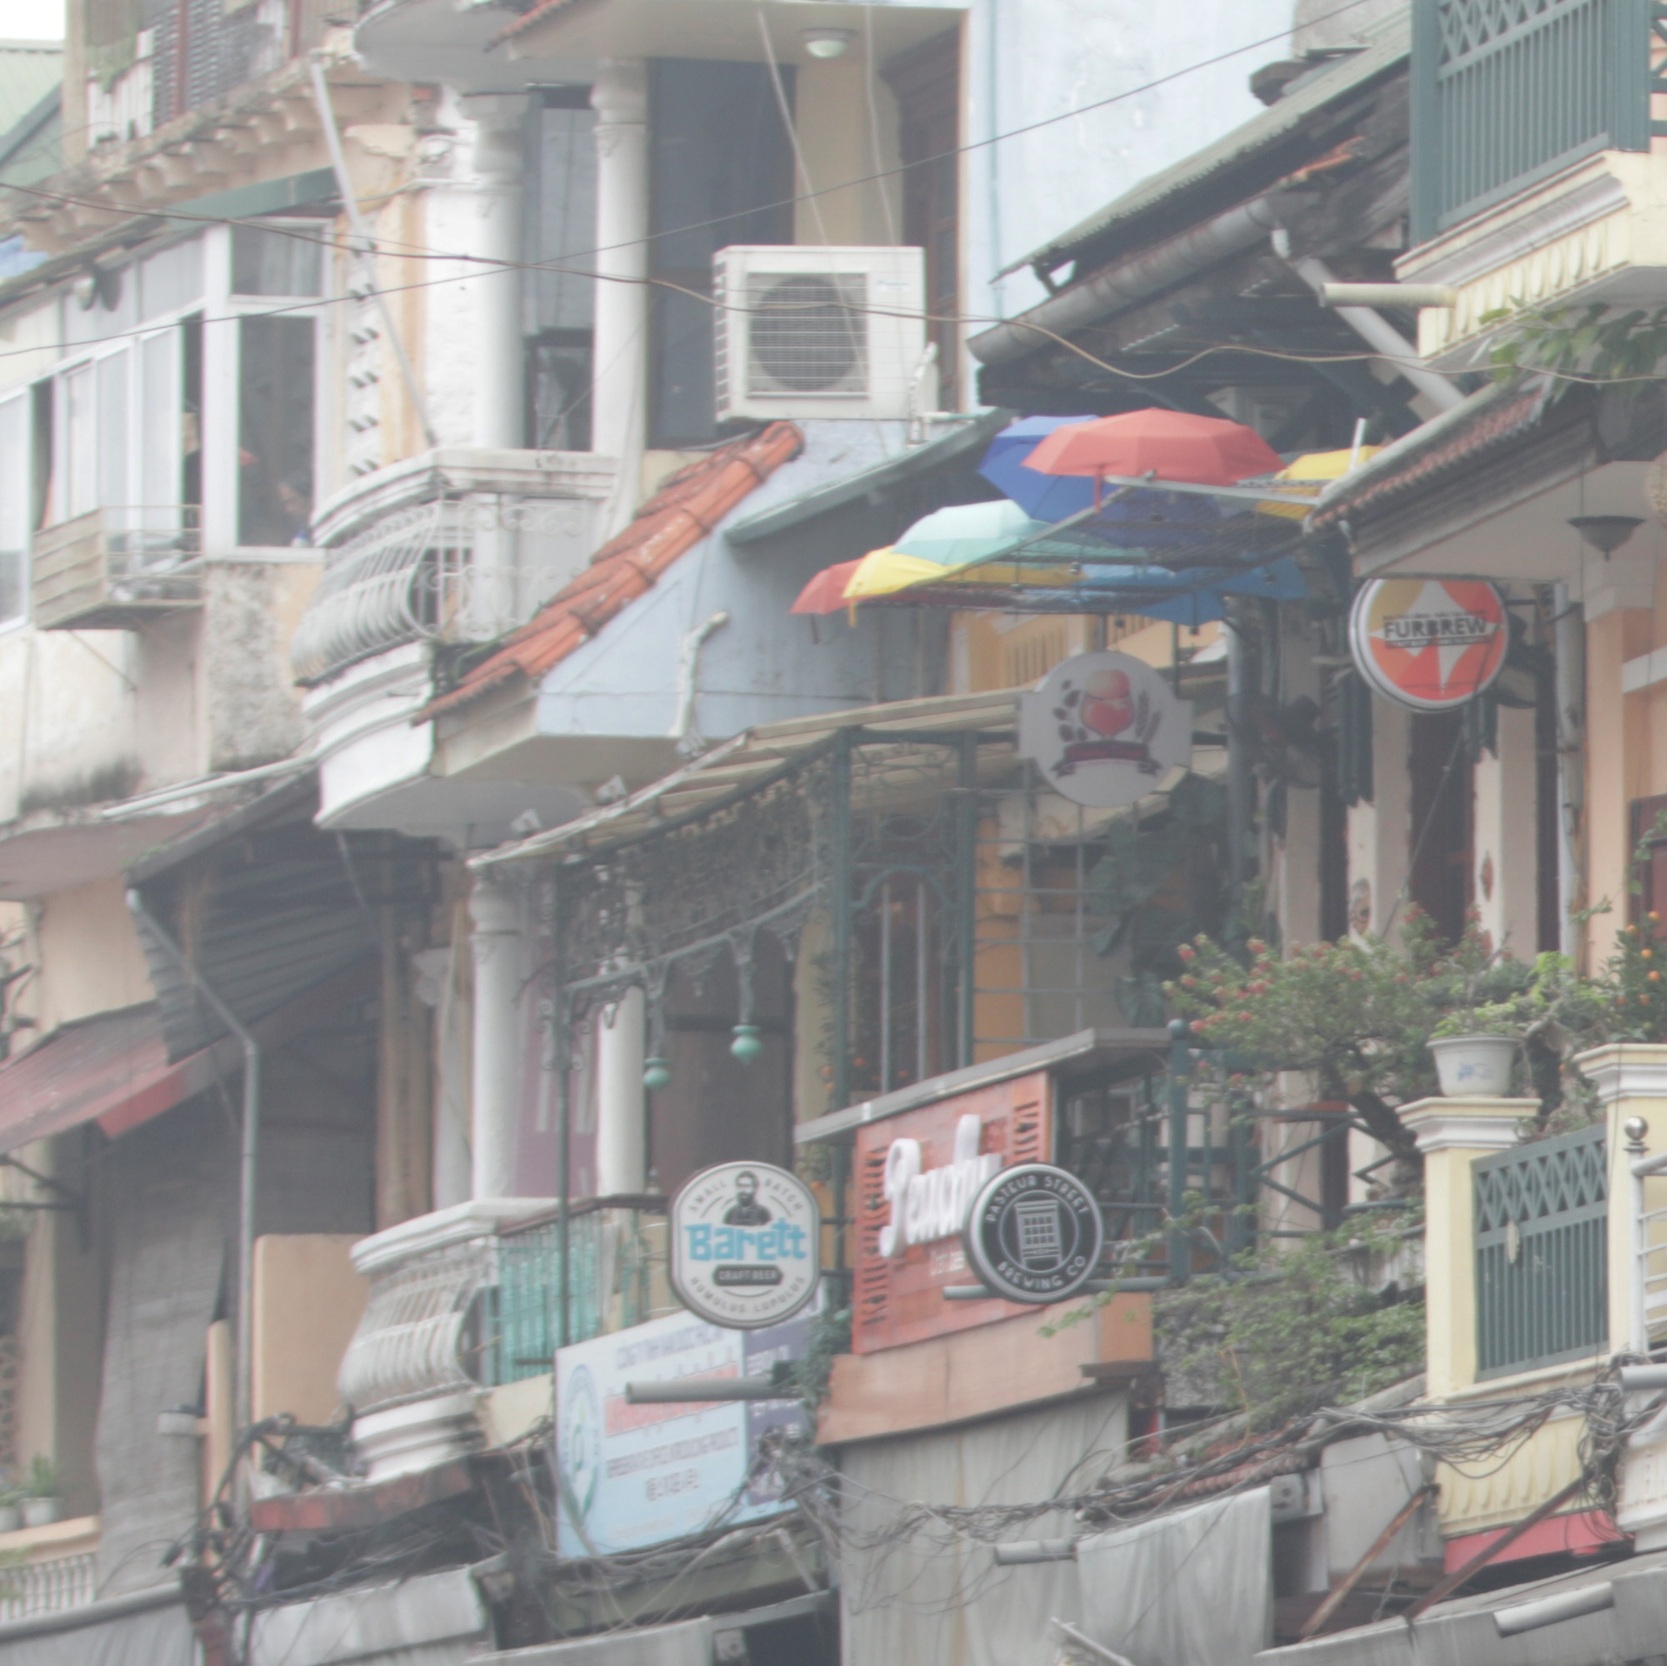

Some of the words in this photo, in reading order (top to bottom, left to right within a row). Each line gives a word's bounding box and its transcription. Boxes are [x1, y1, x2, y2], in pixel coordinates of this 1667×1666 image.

[1384, 618, 1486, 640] FURBREW
[688, 1180, 727, 1212] SMALL
[764, 1177, 803, 1210] BATCH
[986, 1175, 1036, 1222] PASTEUR
[1045, 1174, 1089, 1214] STREET
[684, 1217, 807, 1261] Barett
[998, 1261, 1063, 1289] BREWING
[1066, 1255, 1086, 1277] CO
[689, 1276, 747, 1314] HUMULUS
[754, 1275, 806, 1313] LUPULUS
